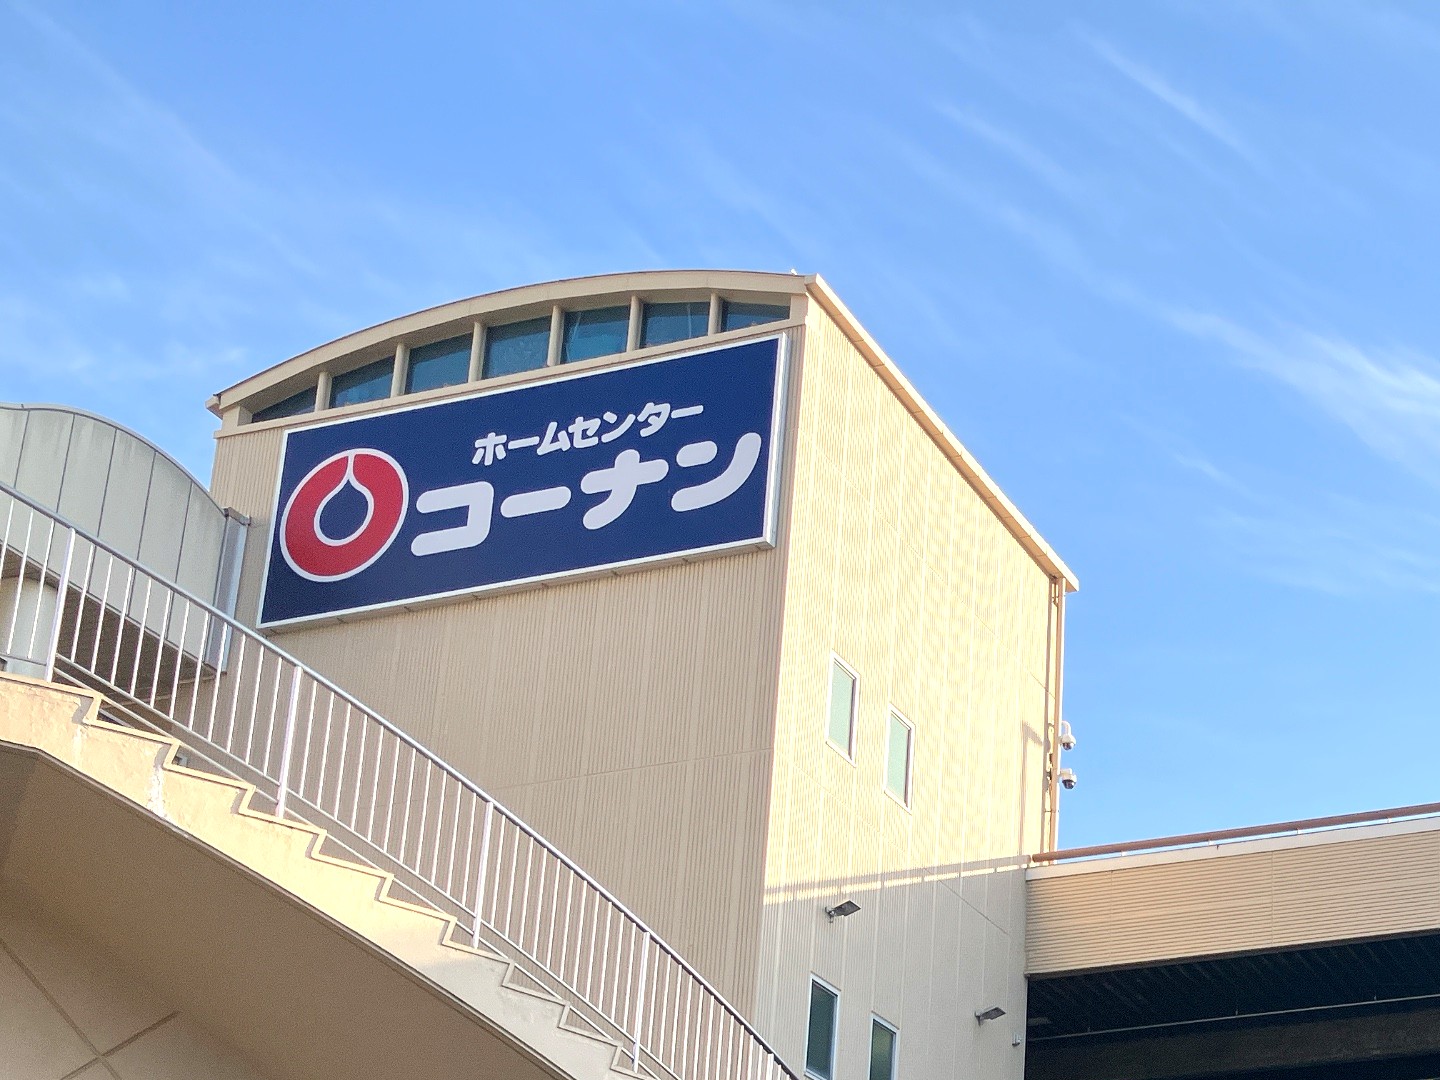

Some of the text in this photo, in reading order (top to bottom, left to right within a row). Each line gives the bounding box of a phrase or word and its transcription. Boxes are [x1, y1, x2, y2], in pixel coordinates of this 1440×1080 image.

[472, 402, 703, 465] ホームセンター
[411, 432, 761, 556] コーナン
